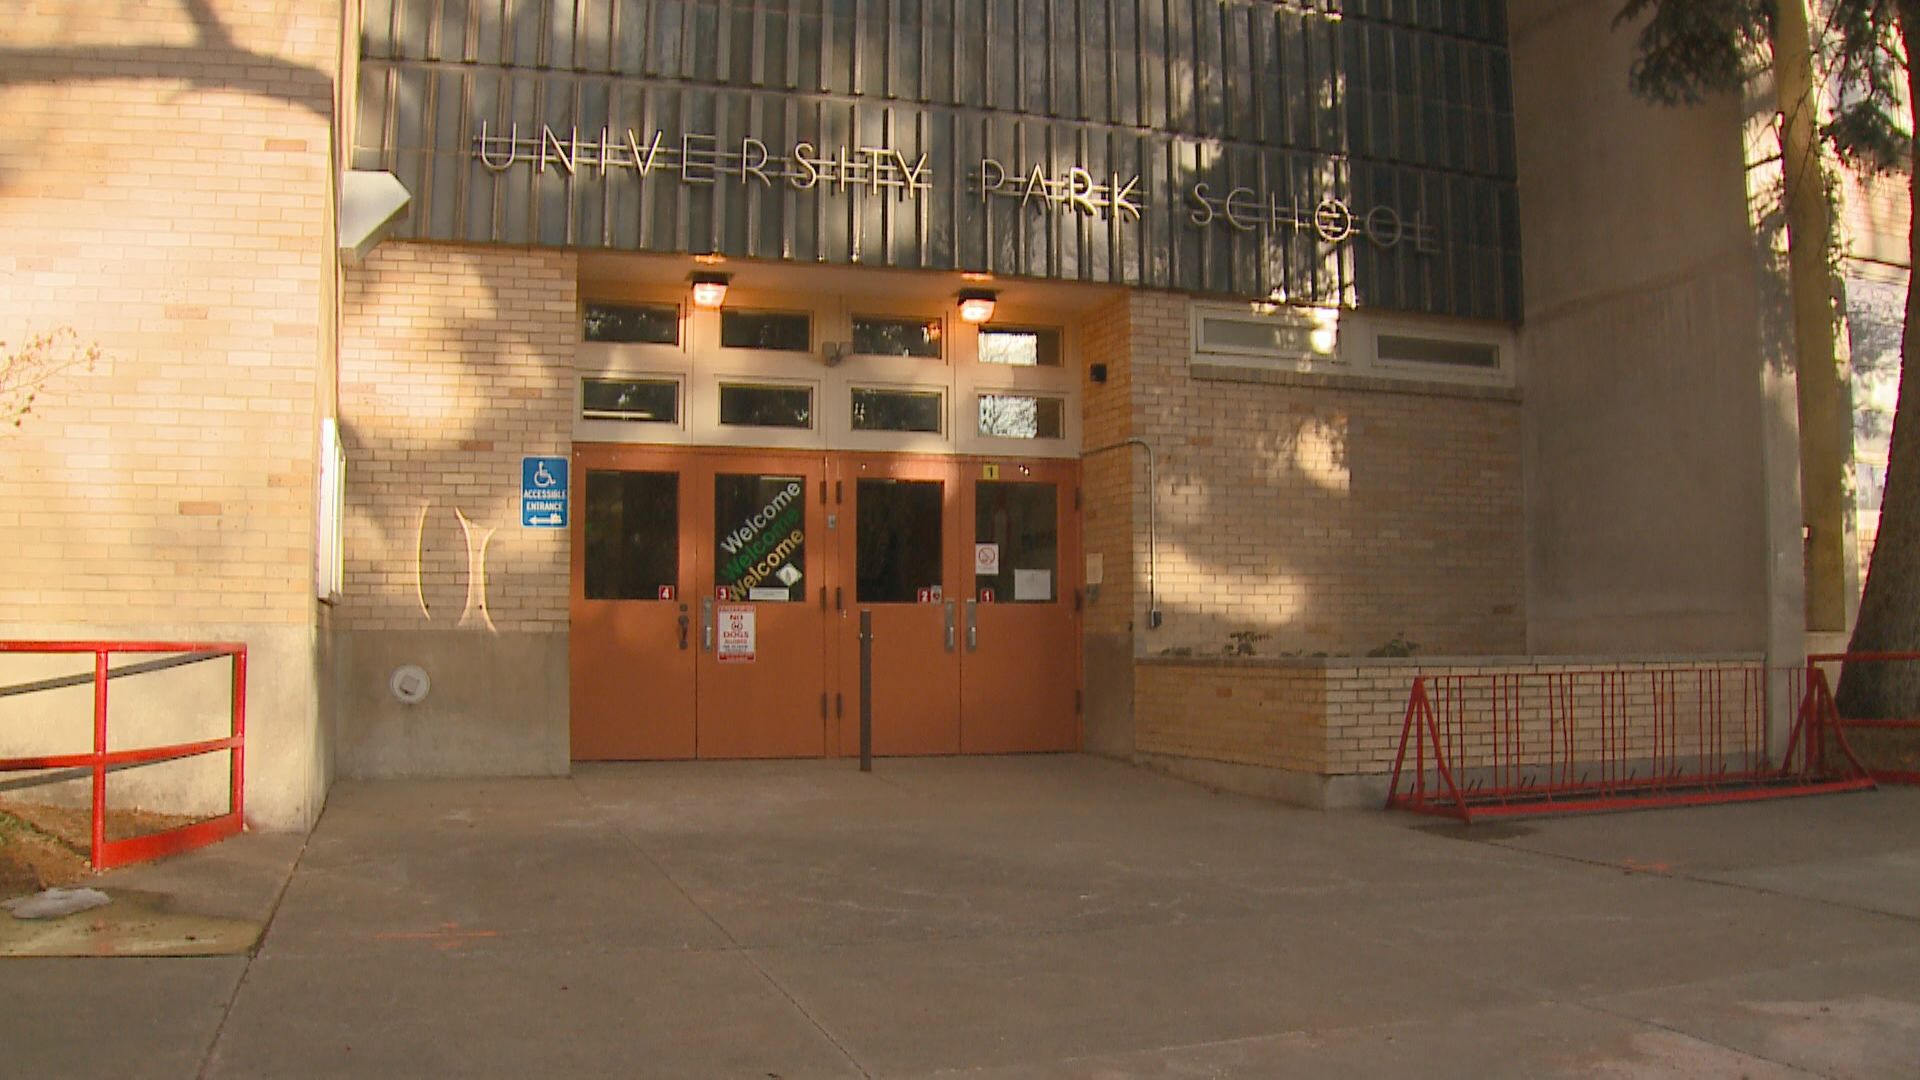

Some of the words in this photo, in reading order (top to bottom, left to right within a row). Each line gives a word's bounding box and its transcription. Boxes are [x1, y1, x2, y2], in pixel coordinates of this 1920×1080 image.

[479, 119, 929, 200] UNIVERSITY
[980, 158, 1141, 221] PARK
[1190, 182, 1441, 253] SCHOOL
[523, 489, 567, 500] ACCESSIBLE
[526, 501, 563, 512] ENTRANCE
[720, 482, 801, 555] Welcome
[719, 508, 800, 581] Welcome
[729, 529, 804, 602] Welcome
[661, 588, 670, 599] 4
[719, 588, 727, 599] 3
[921, 590, 929, 601] 2
